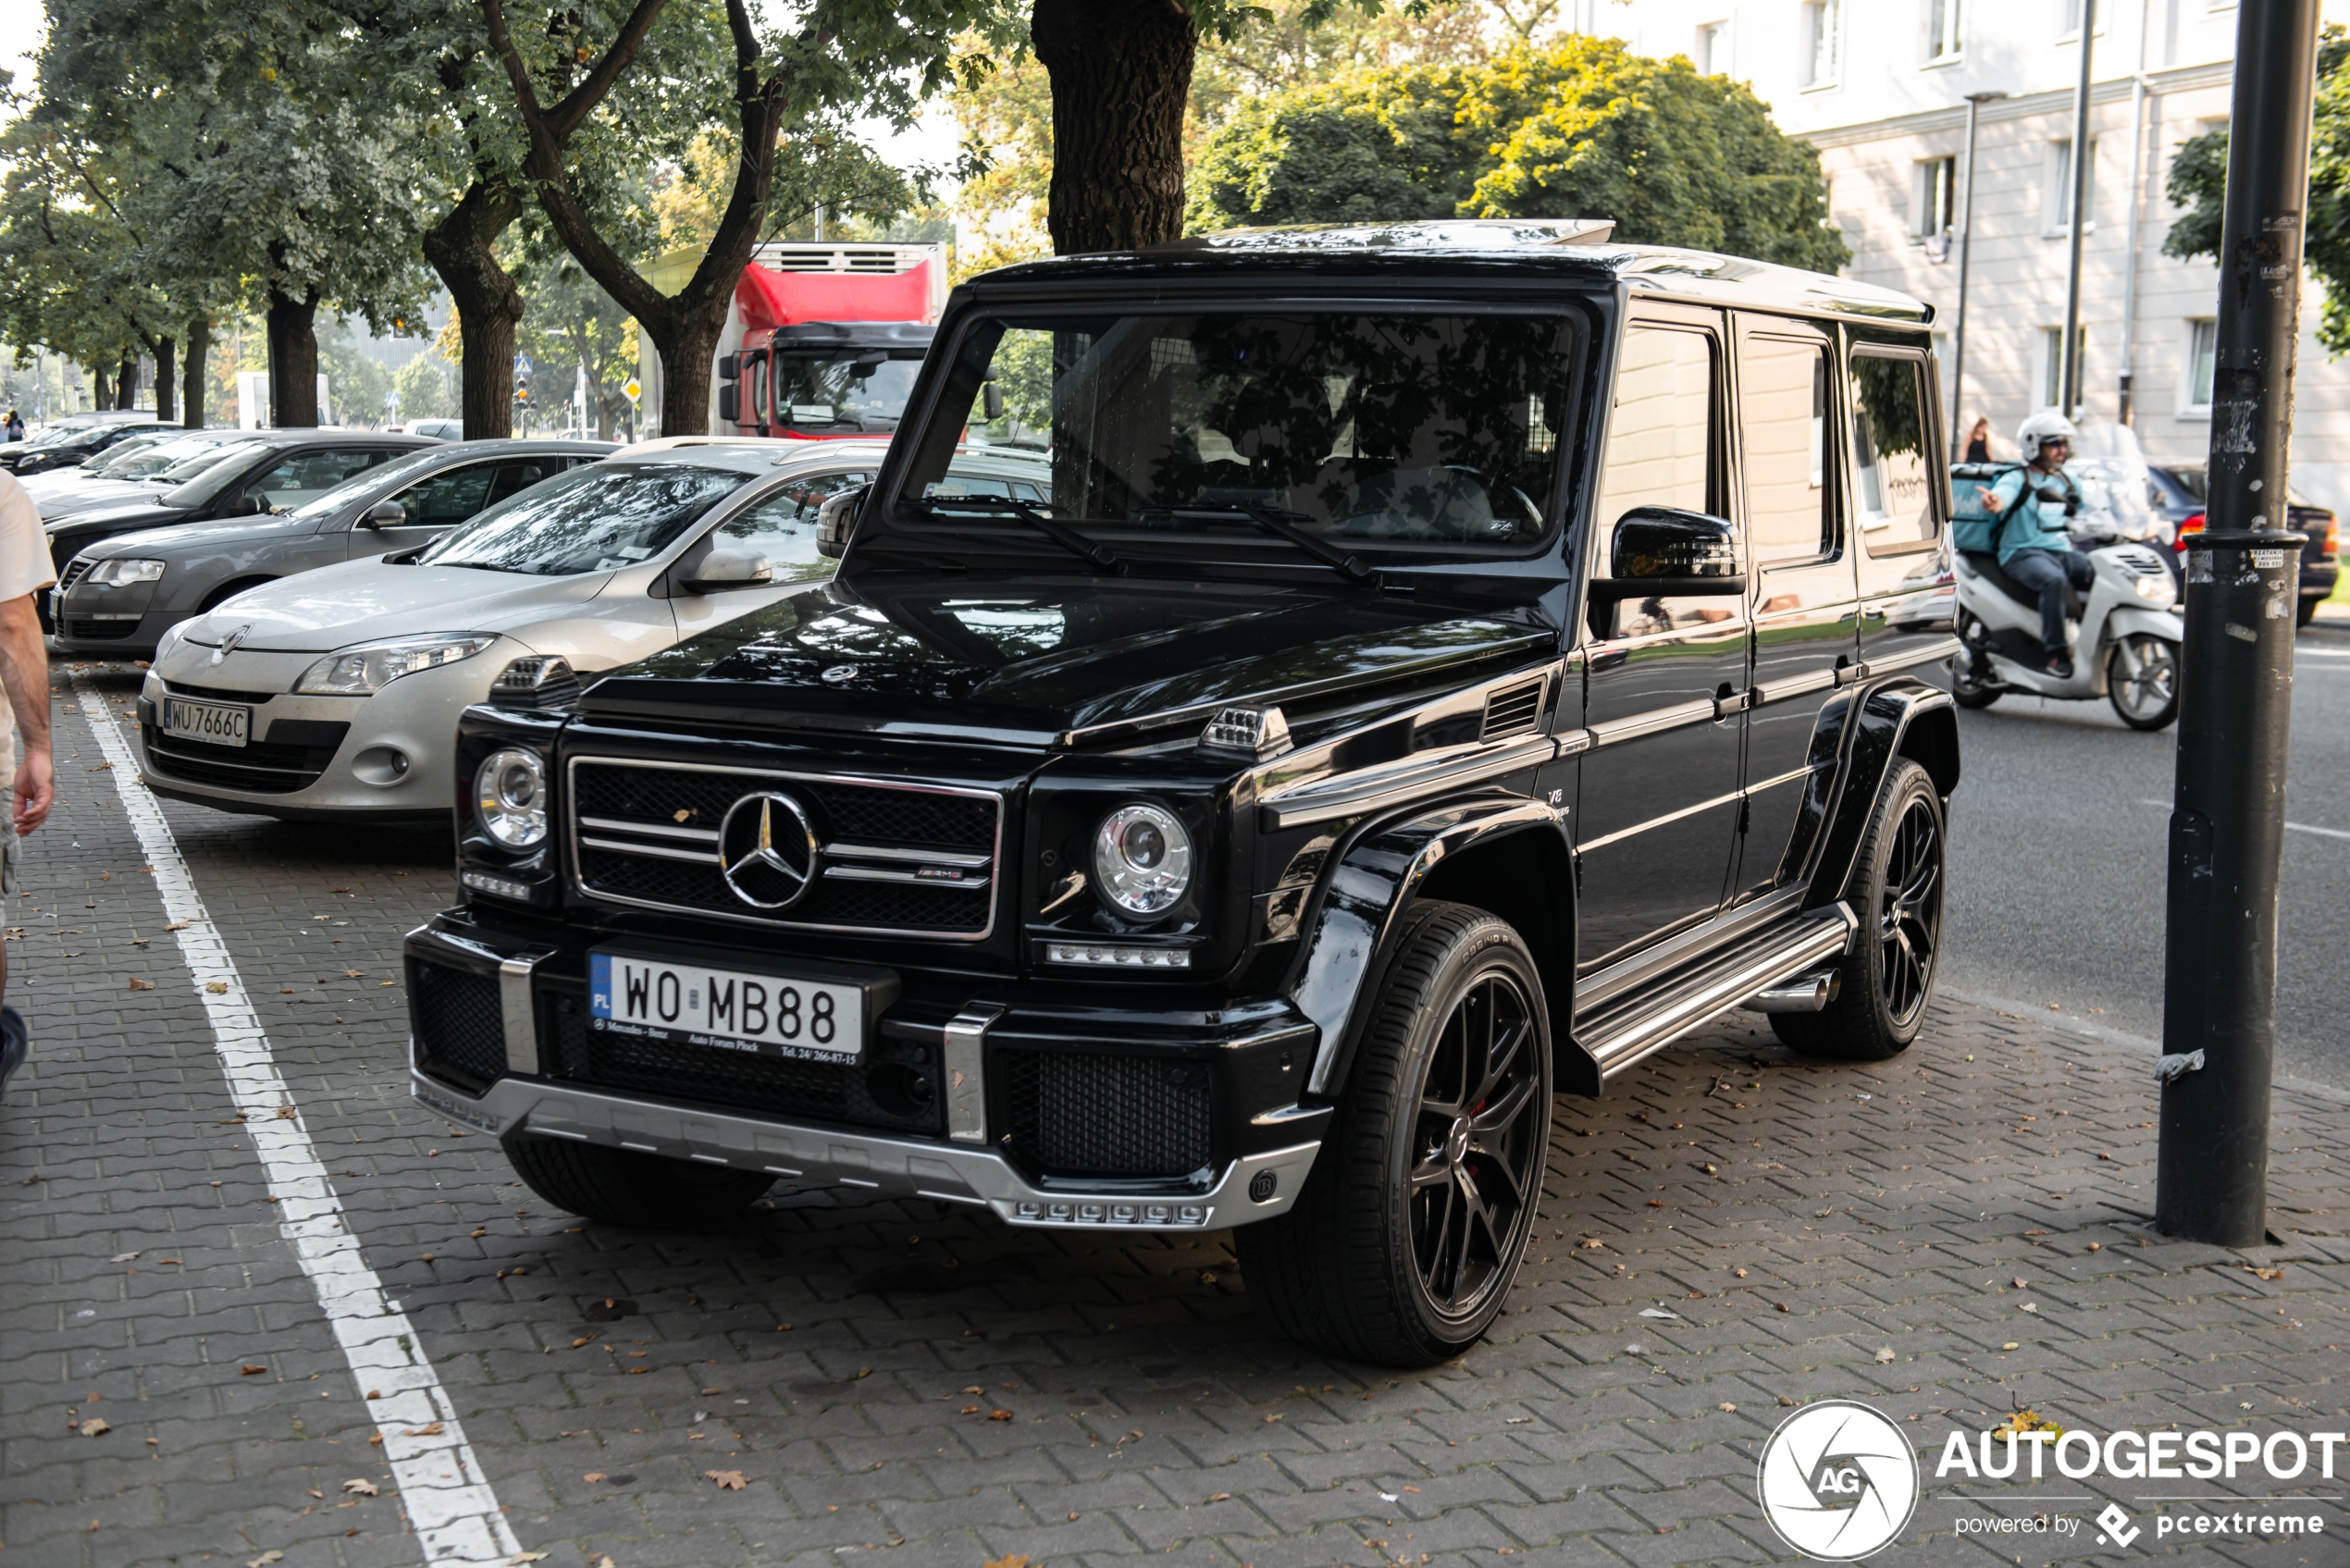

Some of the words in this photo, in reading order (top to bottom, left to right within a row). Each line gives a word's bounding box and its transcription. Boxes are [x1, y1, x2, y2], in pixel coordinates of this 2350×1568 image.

[172, 703, 192, 730] WU
[195, 707, 244, 738] 7666C
[1548, 788, 1563, 804] V8
[593, 993, 611, 1009] PL
[625, 965, 680, 1023] WO
[708, 976, 835, 1044] MB88
[607, 1021, 643, 1035] Mercedes
[648, 1027, 669, 1040] Benz
[688, 1033, 708, 1045] Auto
[709, 1036, 736, 1049] Forum
